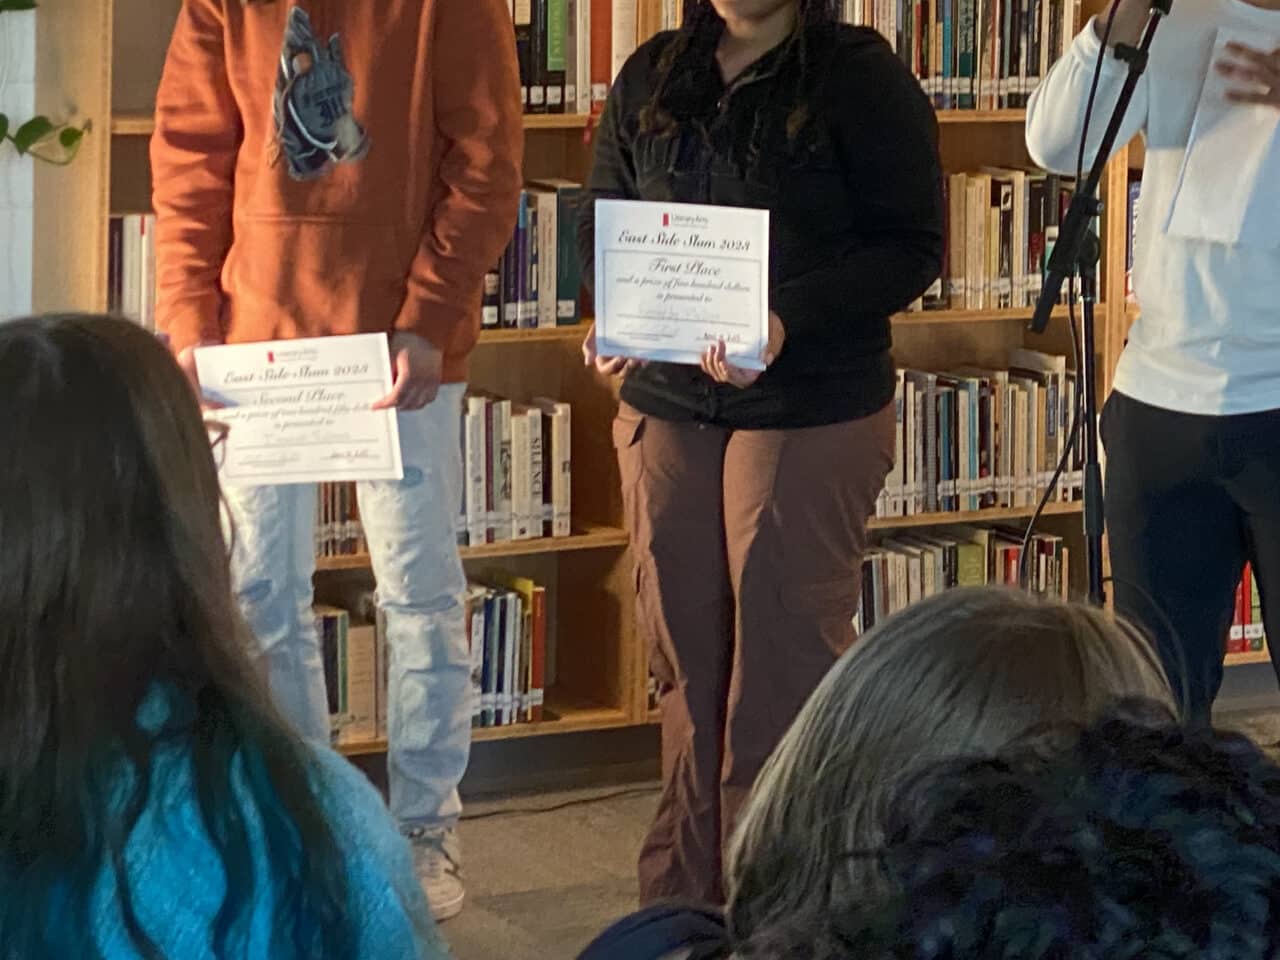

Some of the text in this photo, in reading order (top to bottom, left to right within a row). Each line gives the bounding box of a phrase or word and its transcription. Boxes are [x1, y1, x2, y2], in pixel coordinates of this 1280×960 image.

[618, 229, 648, 244] East
[651, 231, 680, 246] Side
[683, 234, 716, 249] Slam
[648, 257, 721, 276] First Place
[223, 370, 255, 384] East
[259, 367, 289, 382] Side
[253, 388, 345, 406] Second Place
